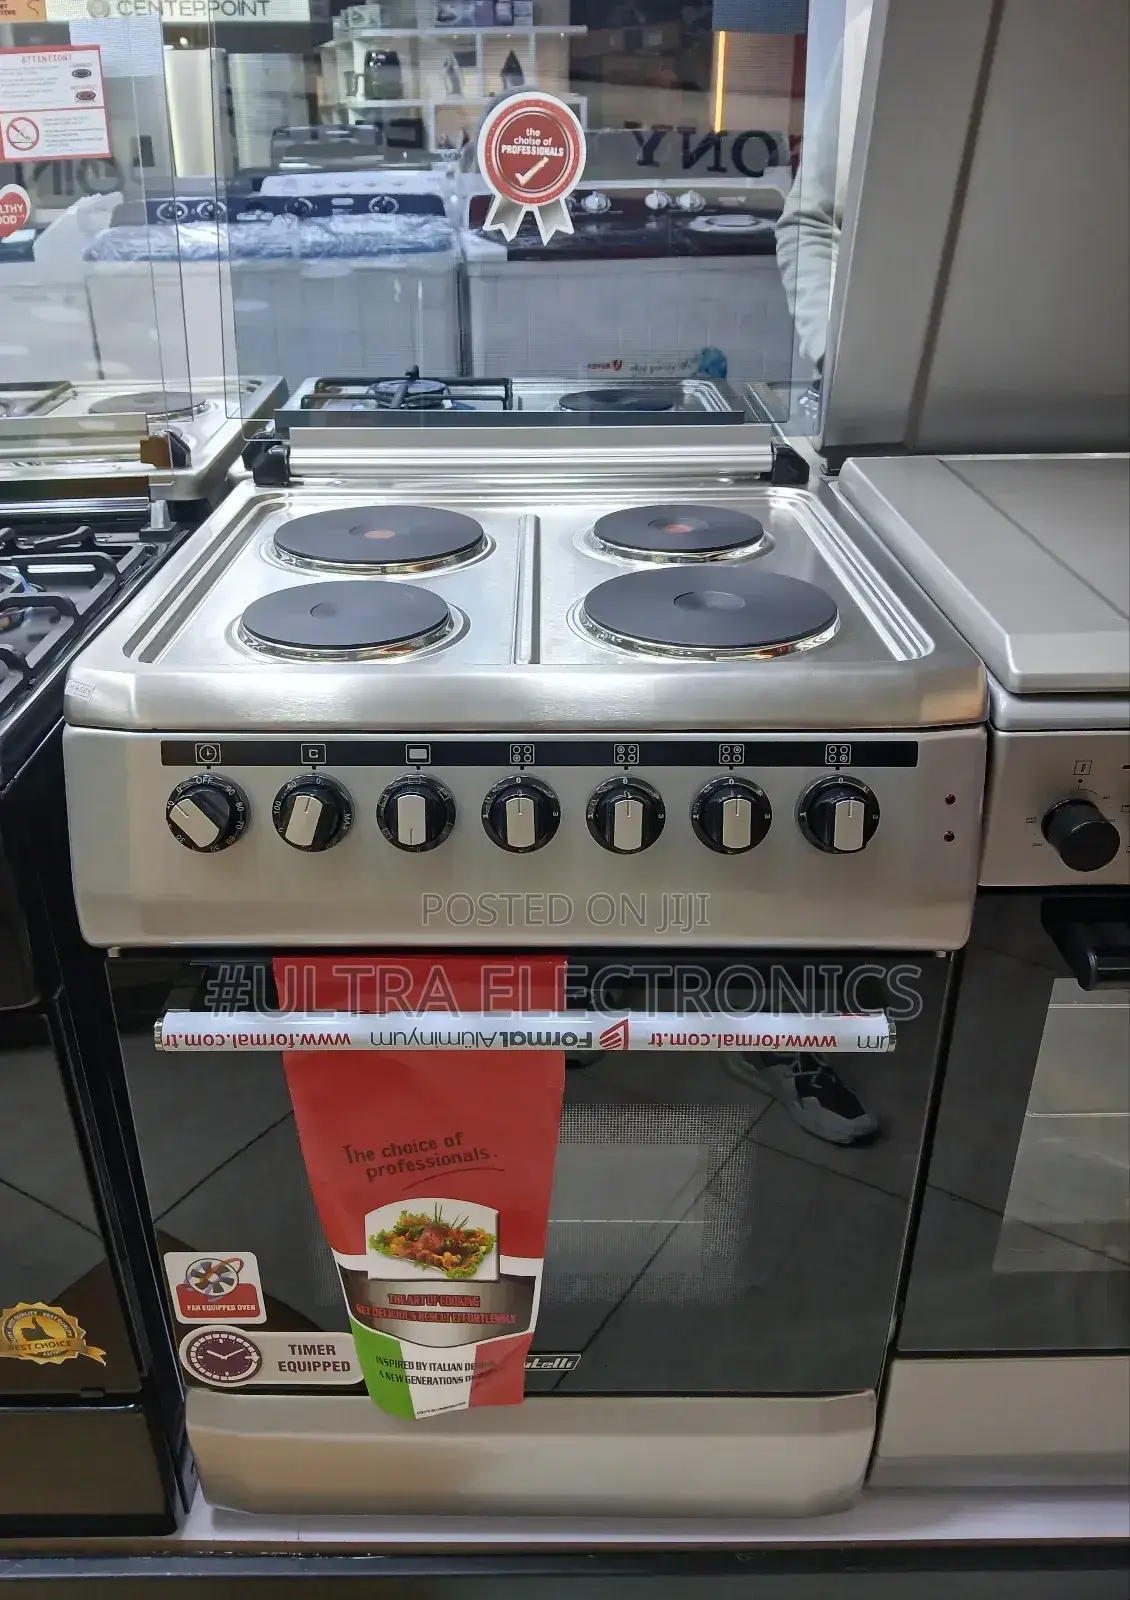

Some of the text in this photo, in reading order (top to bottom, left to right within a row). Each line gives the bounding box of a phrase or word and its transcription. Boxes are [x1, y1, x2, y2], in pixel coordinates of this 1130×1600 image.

[118, 0, 271, 16] CENTERPOINT
[22, 54, 72, 64] ATTENTION!
[525, 127, 541, 136] the
[543, 137, 553, 146] of
[501, 144, 565, 157] PROFESSIONALS
[195, 776, 214, 785] OFF
[163, 1032, 351, 1049] www.formal.com.tr
[648, 1031, 837, 1049] www.formal.com.tr
[342, 1131, 463, 1164] The choice of
[34, 1340, 72, 1349] CHOICE
[288, 1344, 336, 1356] TIMER
[278, 1361, 351, 1373] EQUIPPED
[376, 1355, 414, 1371] INSPIRED
[416, 1361, 428, 1371] BY
[429, 1361, 462, 1372] ITALIAN
[386, 1373, 403, 1383] NEW
[405, 1374, 463, 1385] GENERATIONS
